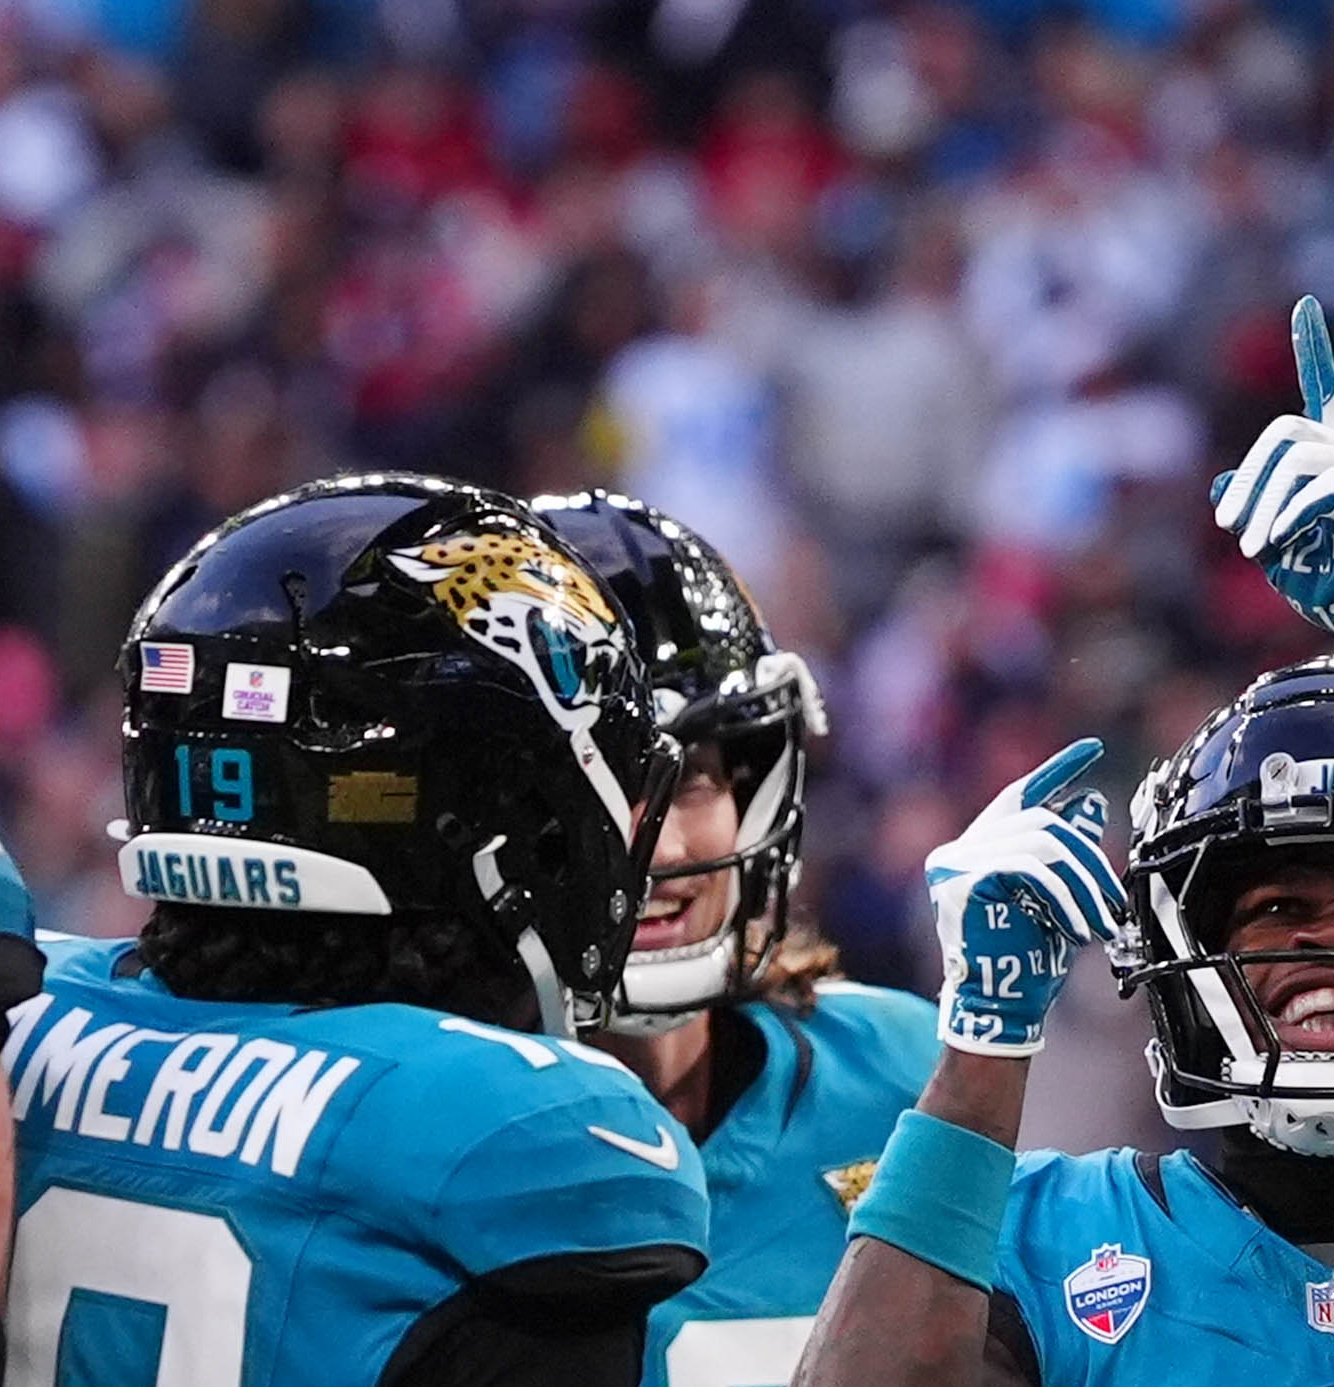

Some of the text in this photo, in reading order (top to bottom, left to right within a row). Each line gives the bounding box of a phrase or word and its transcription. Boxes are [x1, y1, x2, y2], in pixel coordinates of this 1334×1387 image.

[175, 744, 253, 821] 19
[136, 849, 301, 905] JAGUARS
[984, 902, 1011, 930] 12
[975, 954, 1023, 999] 12
[1027, 949, 1046, 976] 12
[1075, 1280, 1143, 1309] LONDON
